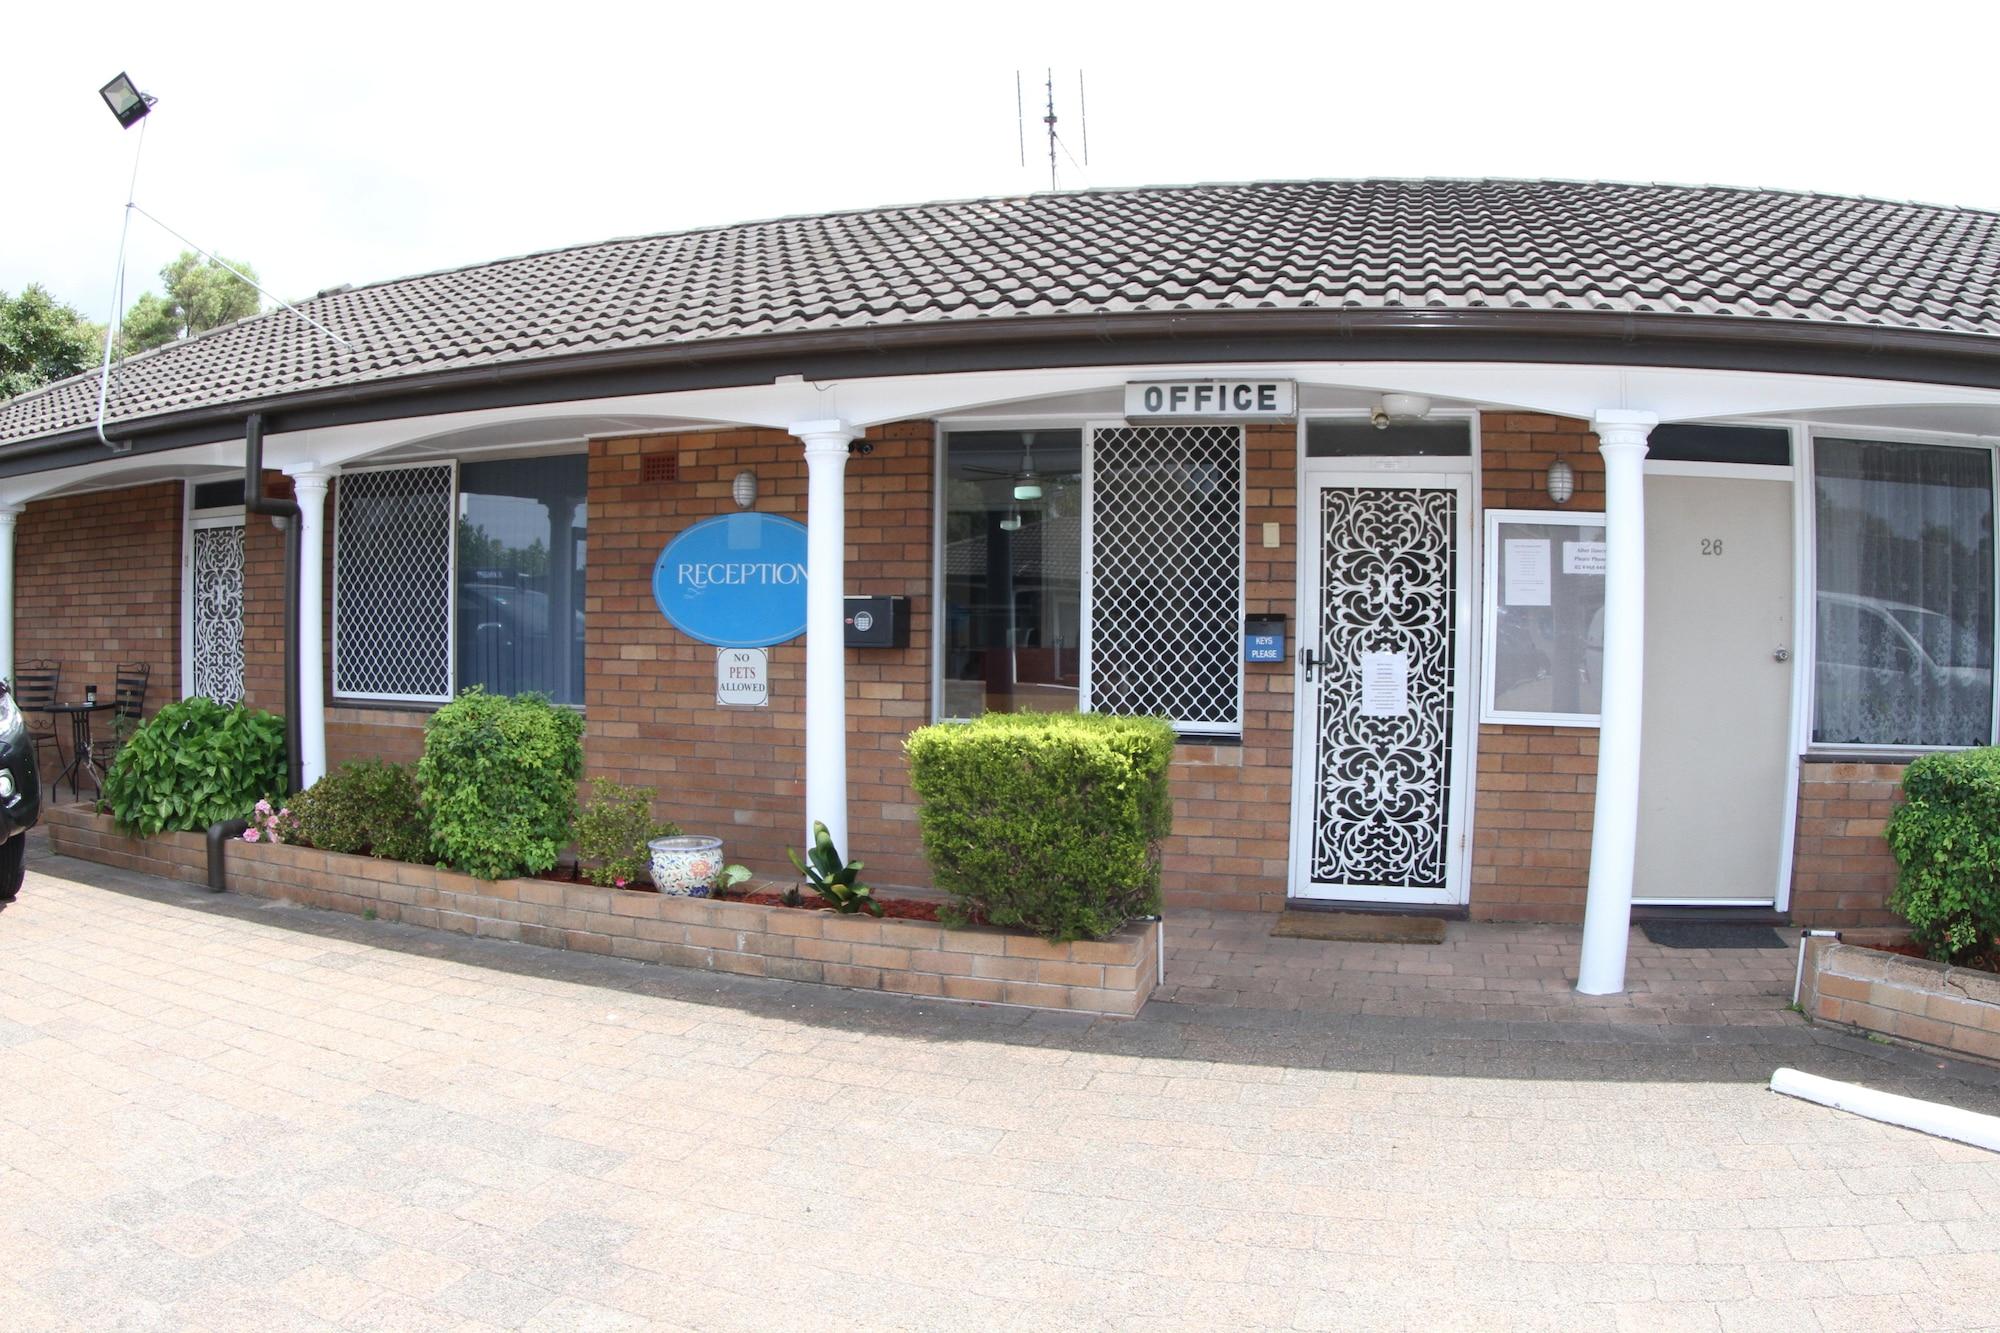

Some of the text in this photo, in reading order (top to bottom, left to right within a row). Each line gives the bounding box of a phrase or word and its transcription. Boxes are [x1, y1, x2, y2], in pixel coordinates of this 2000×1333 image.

[1144, 384, 1277, 412] OFFICE
[1701, 538, 1722, 556] 26
[678, 563, 809, 588] RECEPTION
[1255, 636, 1273, 645] KEYS
[733, 653, 750, 662] NO
[1251, 649, 1277, 658] PLEASE
[729, 666, 756, 679] PETS
[719, 682, 766, 693] ALLOWED
